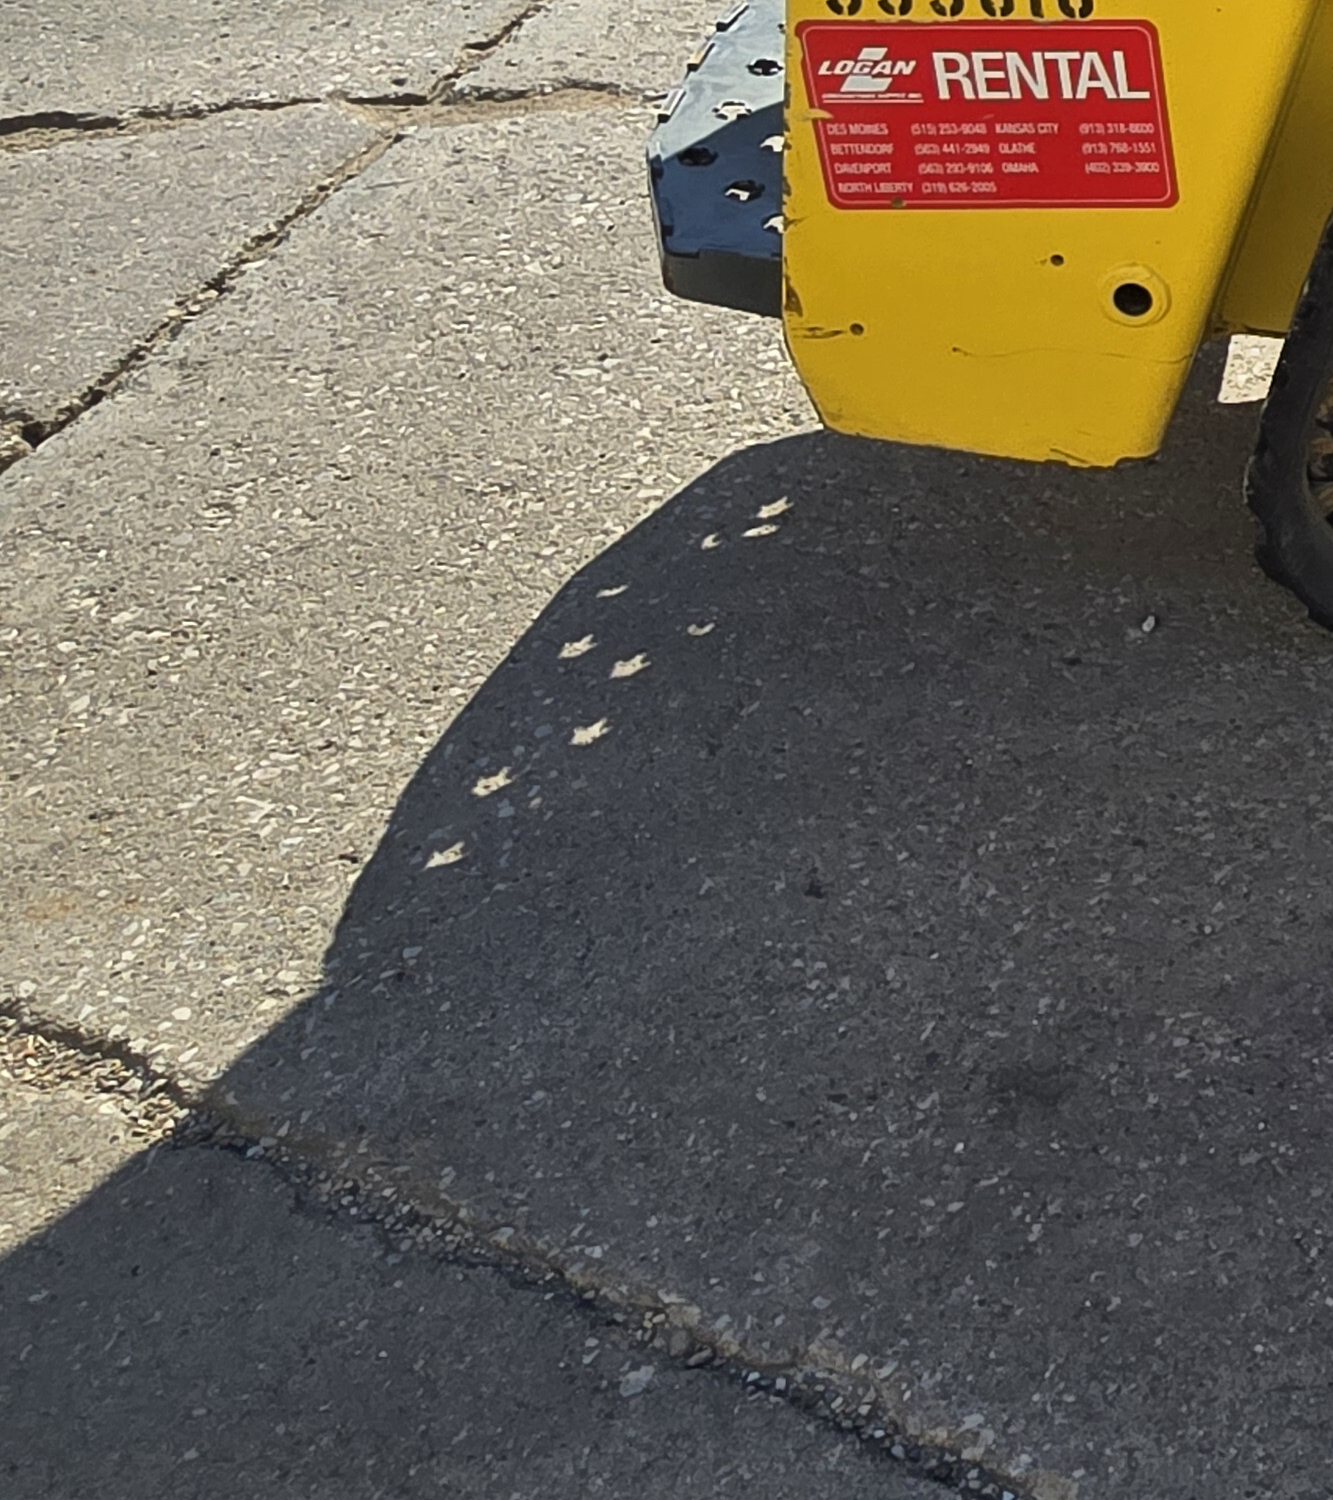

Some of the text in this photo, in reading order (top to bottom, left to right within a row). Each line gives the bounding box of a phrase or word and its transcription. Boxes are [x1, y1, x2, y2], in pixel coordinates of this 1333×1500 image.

[818, 51, 1150, 100] LOGAN RENTAL
[1037, 123, 1058, 135] CITY
